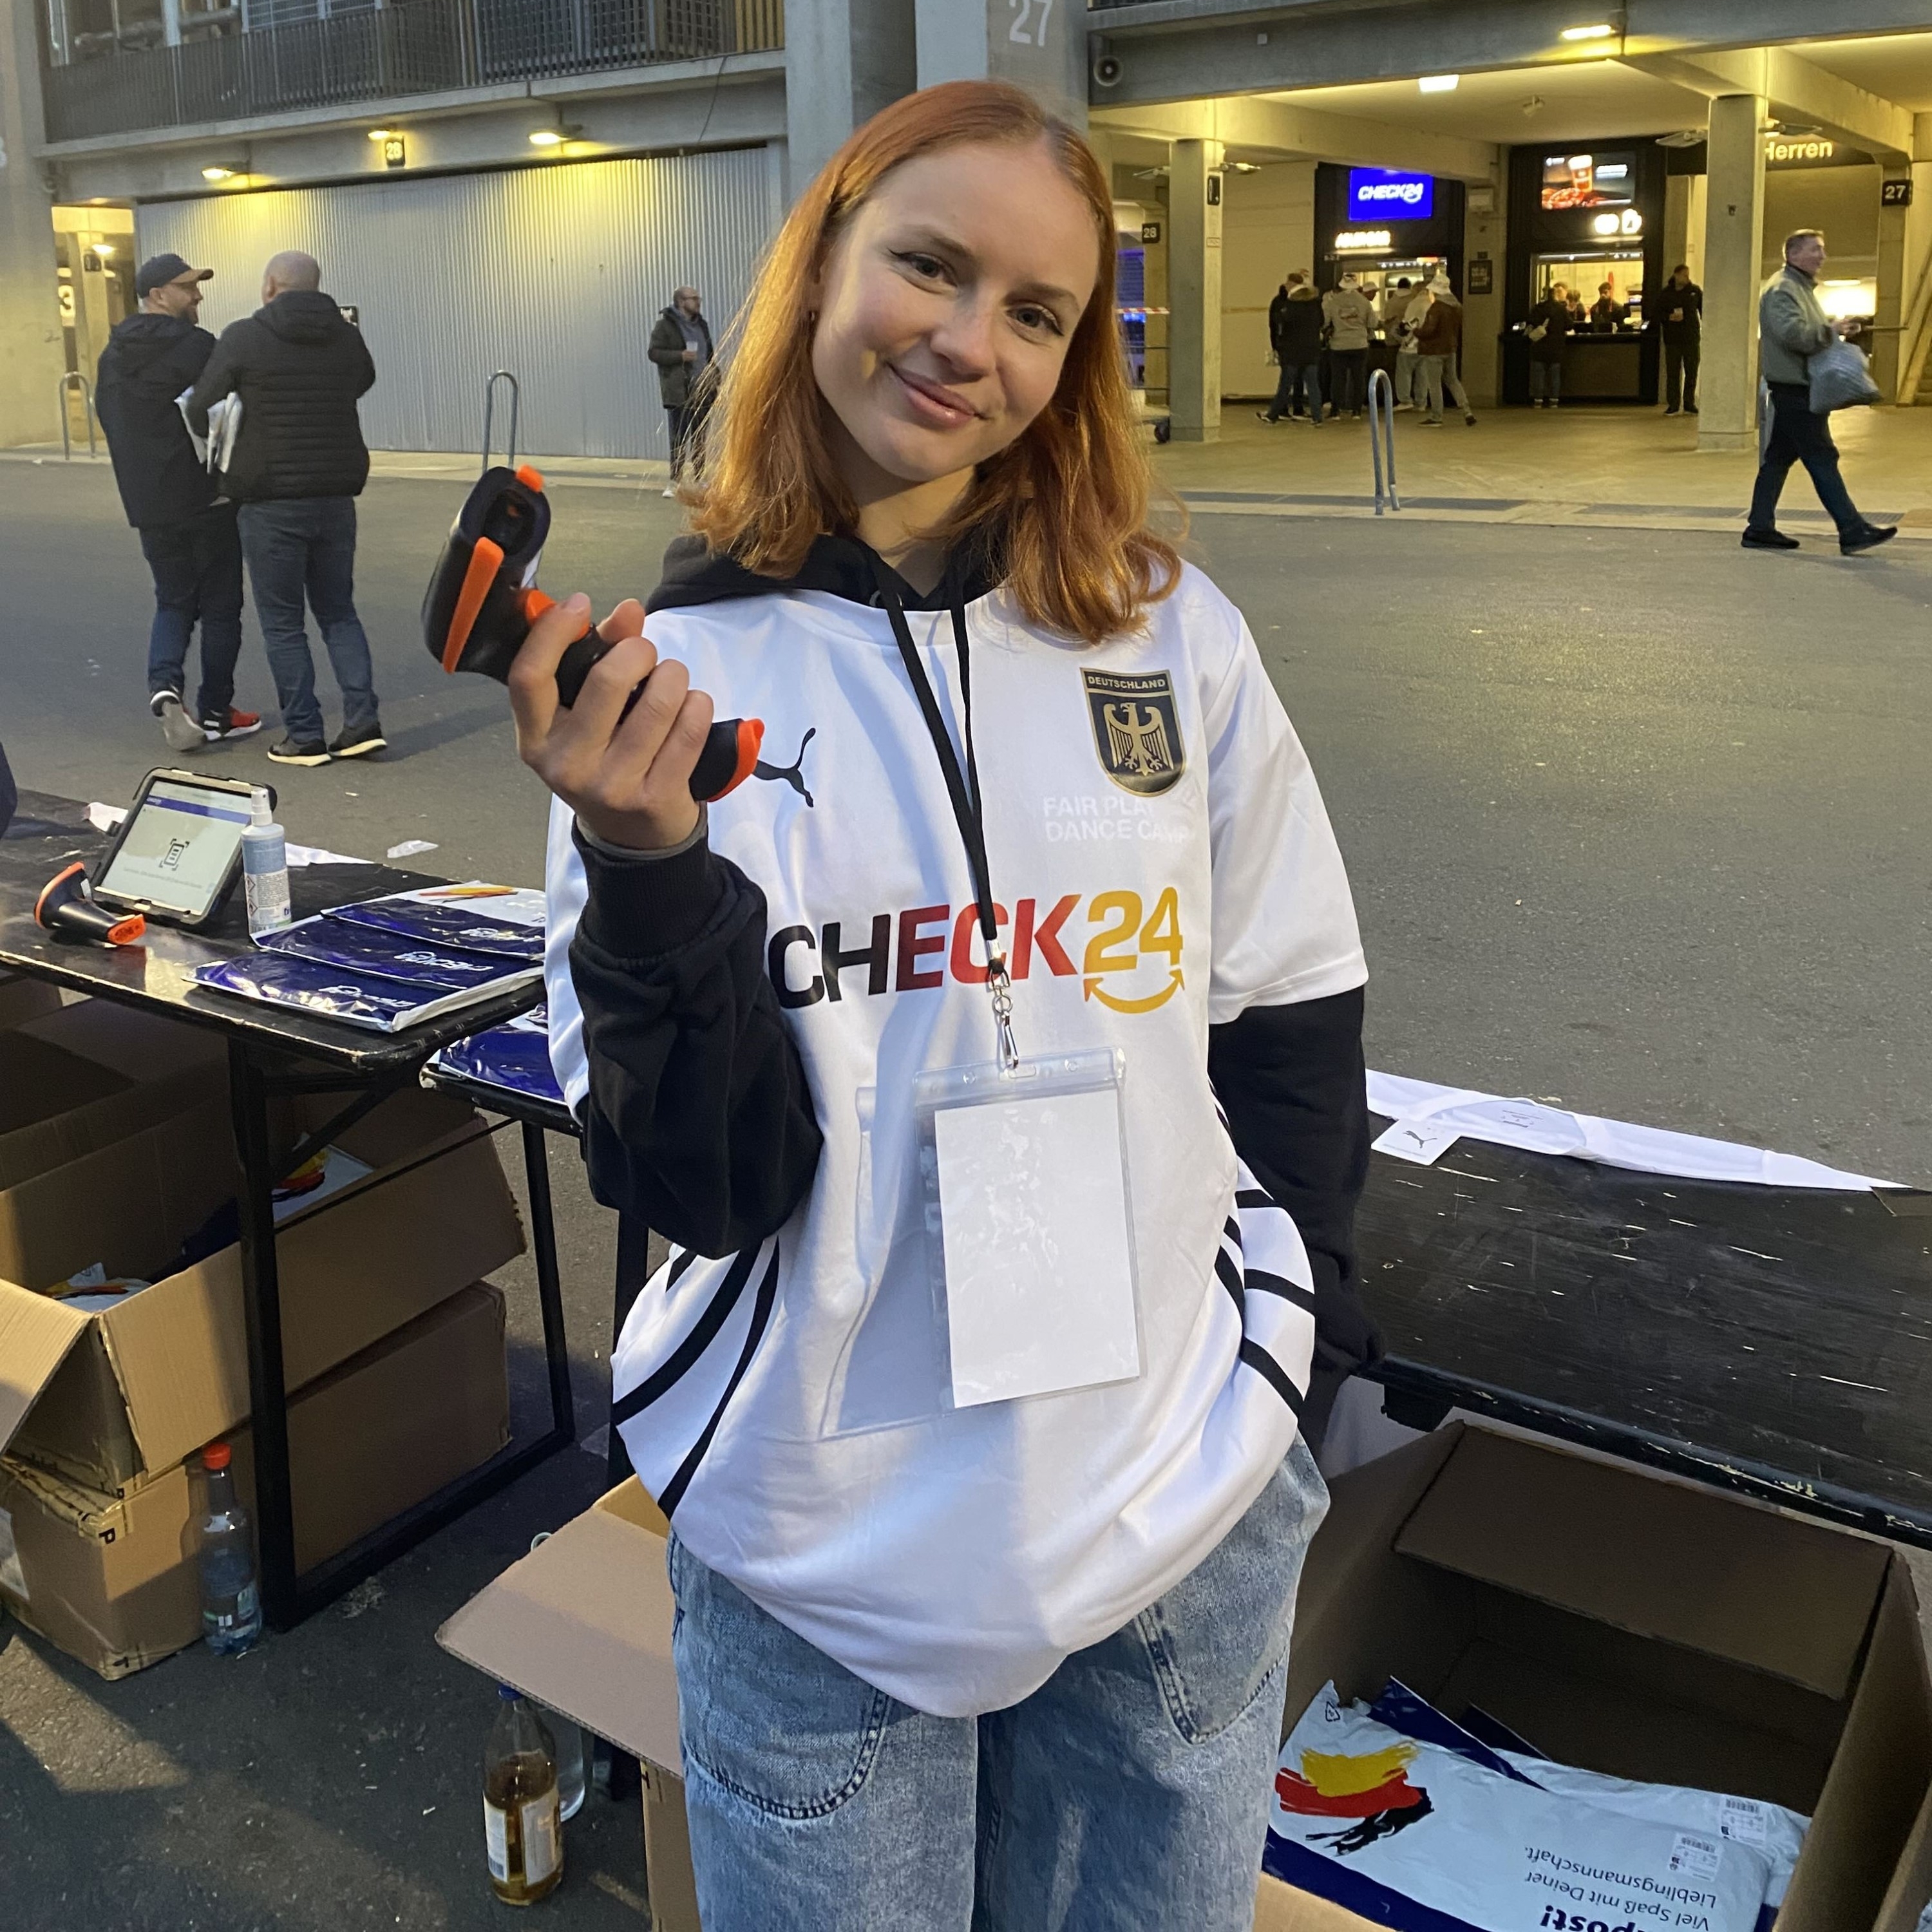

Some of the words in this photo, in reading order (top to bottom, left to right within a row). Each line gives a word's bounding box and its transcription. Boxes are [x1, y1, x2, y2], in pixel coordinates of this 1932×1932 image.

[1009, 0, 1052, 47] 27
[386, 141, 402, 160] 28
[1765, 141, 1833, 160] Herren
[1358, 182, 1424, 204] CHECK24
[1884, 185, 1906, 200] 27
[1143, 227, 1157, 239] 28
[1088, 676, 1166, 690] DEUTSCHLAND
[1043, 796, 1099, 817] FAIR
[1045, 819, 1135, 843] DANCE
[767, 886, 1185, 1010] CHECK24
[1524, 1846, 1717, 1909] Lieblingsmannschaft.
[1524, 1871, 1586, 1901] Deiner
[1588, 1890, 1620, 1908] mit
[1624, 1900, 1672, 1922] Spaß
[1675, 1912, 1709, 1931] Viel
